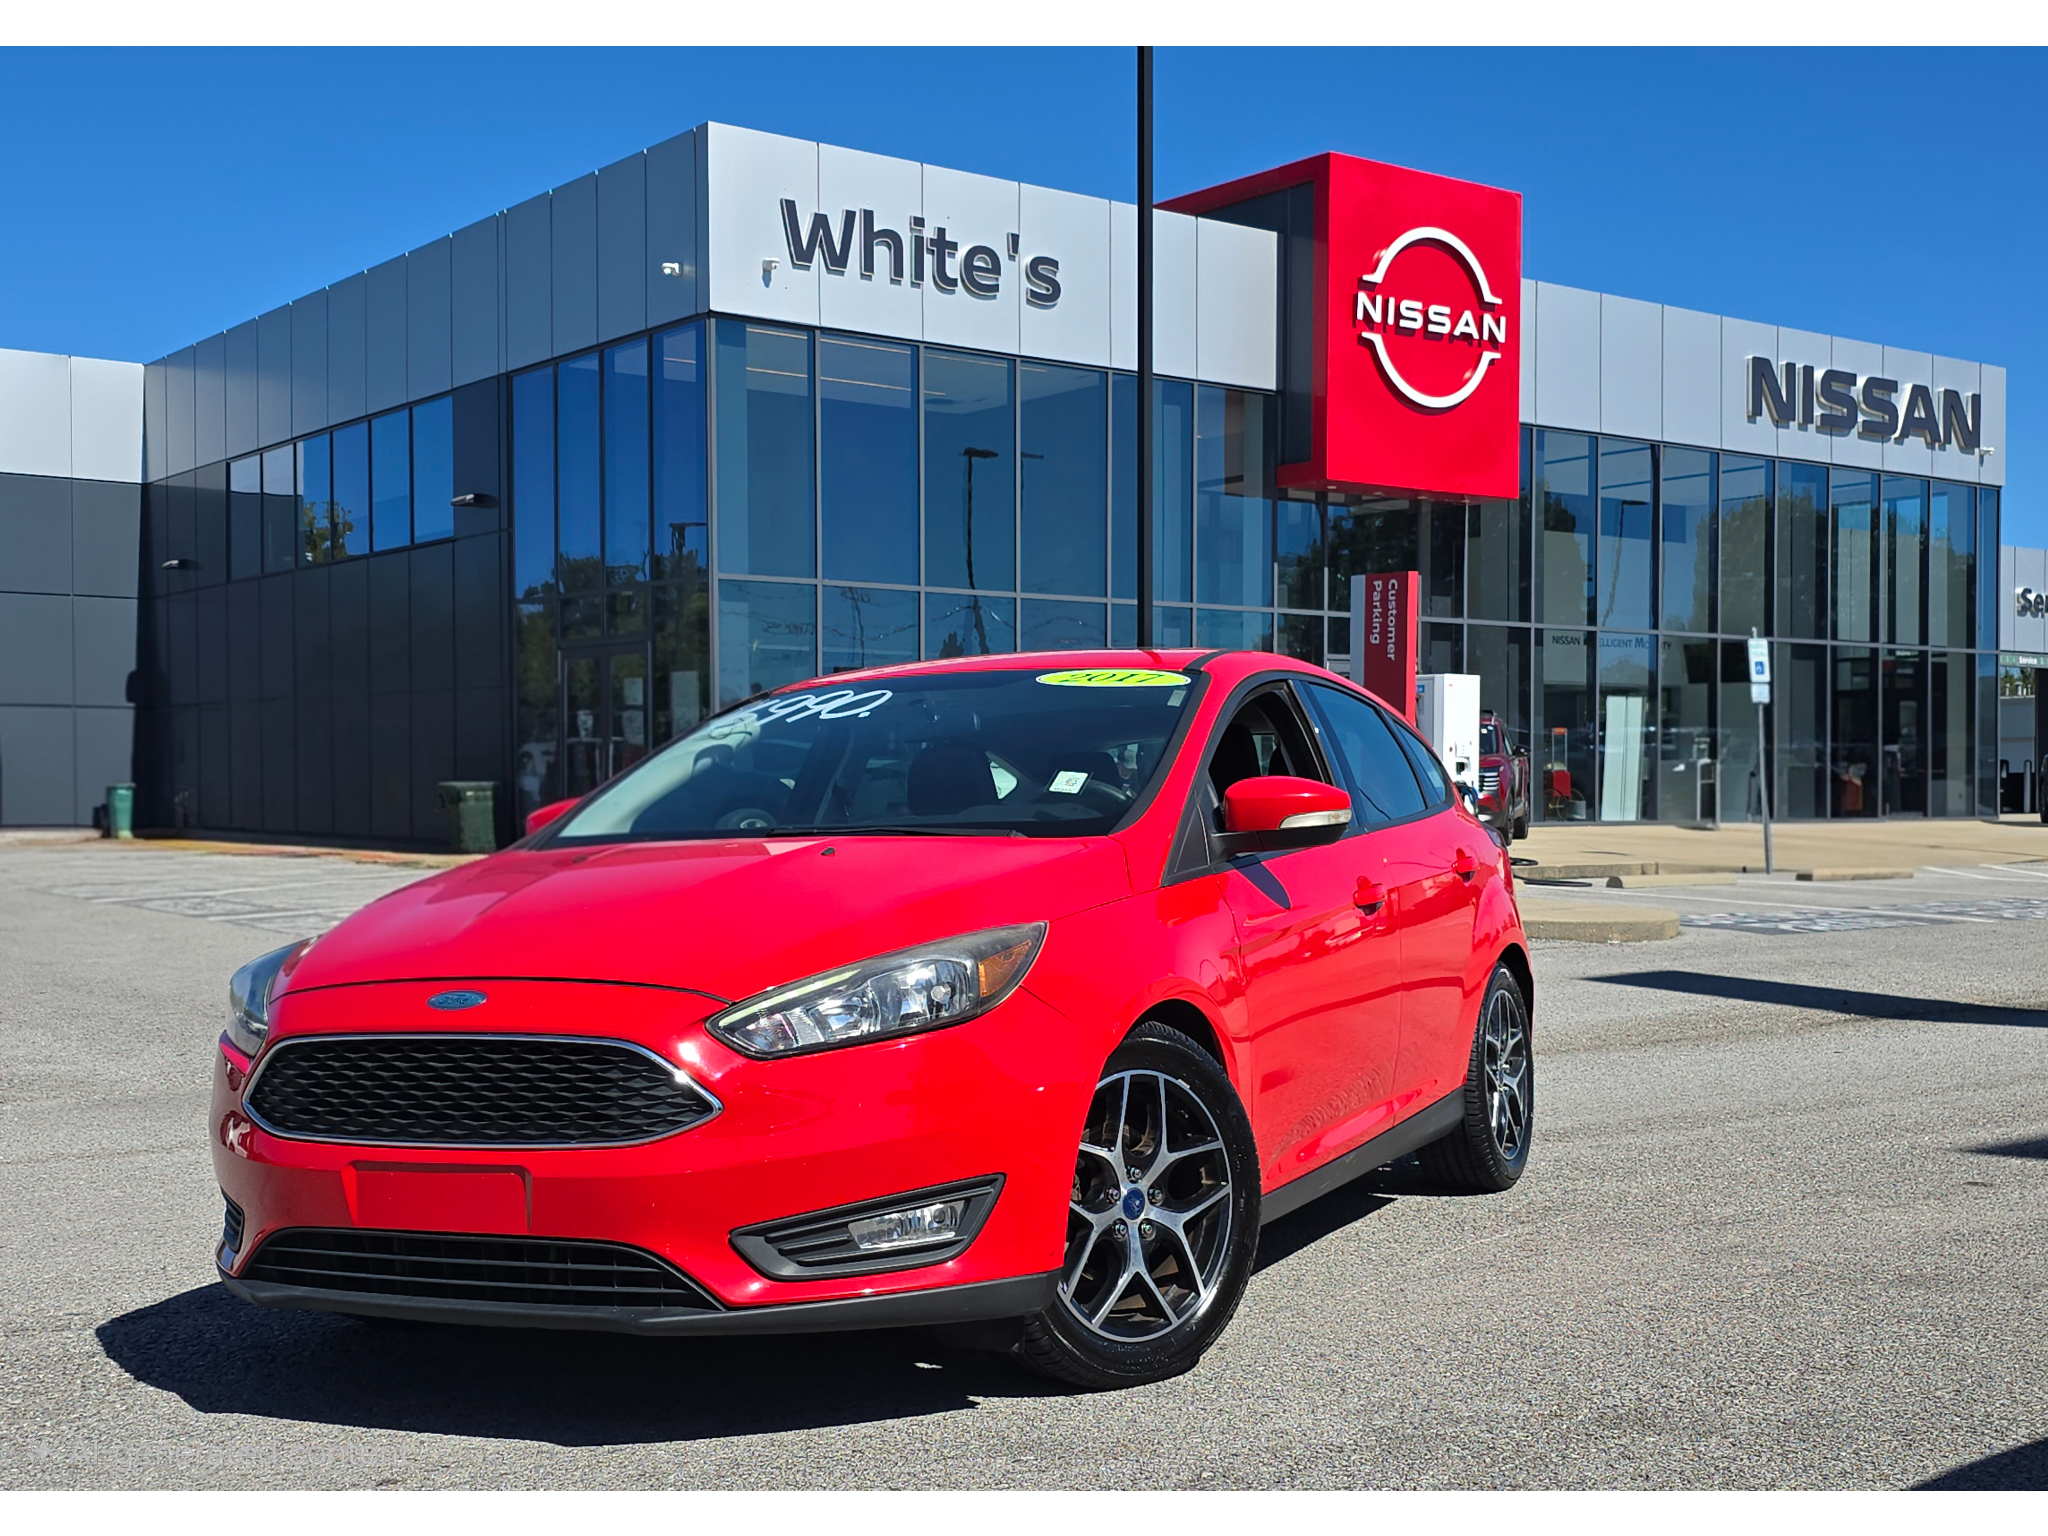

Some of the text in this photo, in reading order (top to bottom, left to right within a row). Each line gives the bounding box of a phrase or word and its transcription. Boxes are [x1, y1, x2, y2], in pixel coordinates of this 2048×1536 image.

[781, 198, 1062, 305] White's
[1356, 291, 1507, 344] NISSAN
[1748, 355, 1982, 450] NISSAN
[1370, 580, 1383, 644] Parking
[1387, 578, 1398, 661] Customer
[2017, 587, 2048, 616] Se
[1552, 635, 1581, 646] NISSAN
[1058, 673, 1165, 683] 2017
